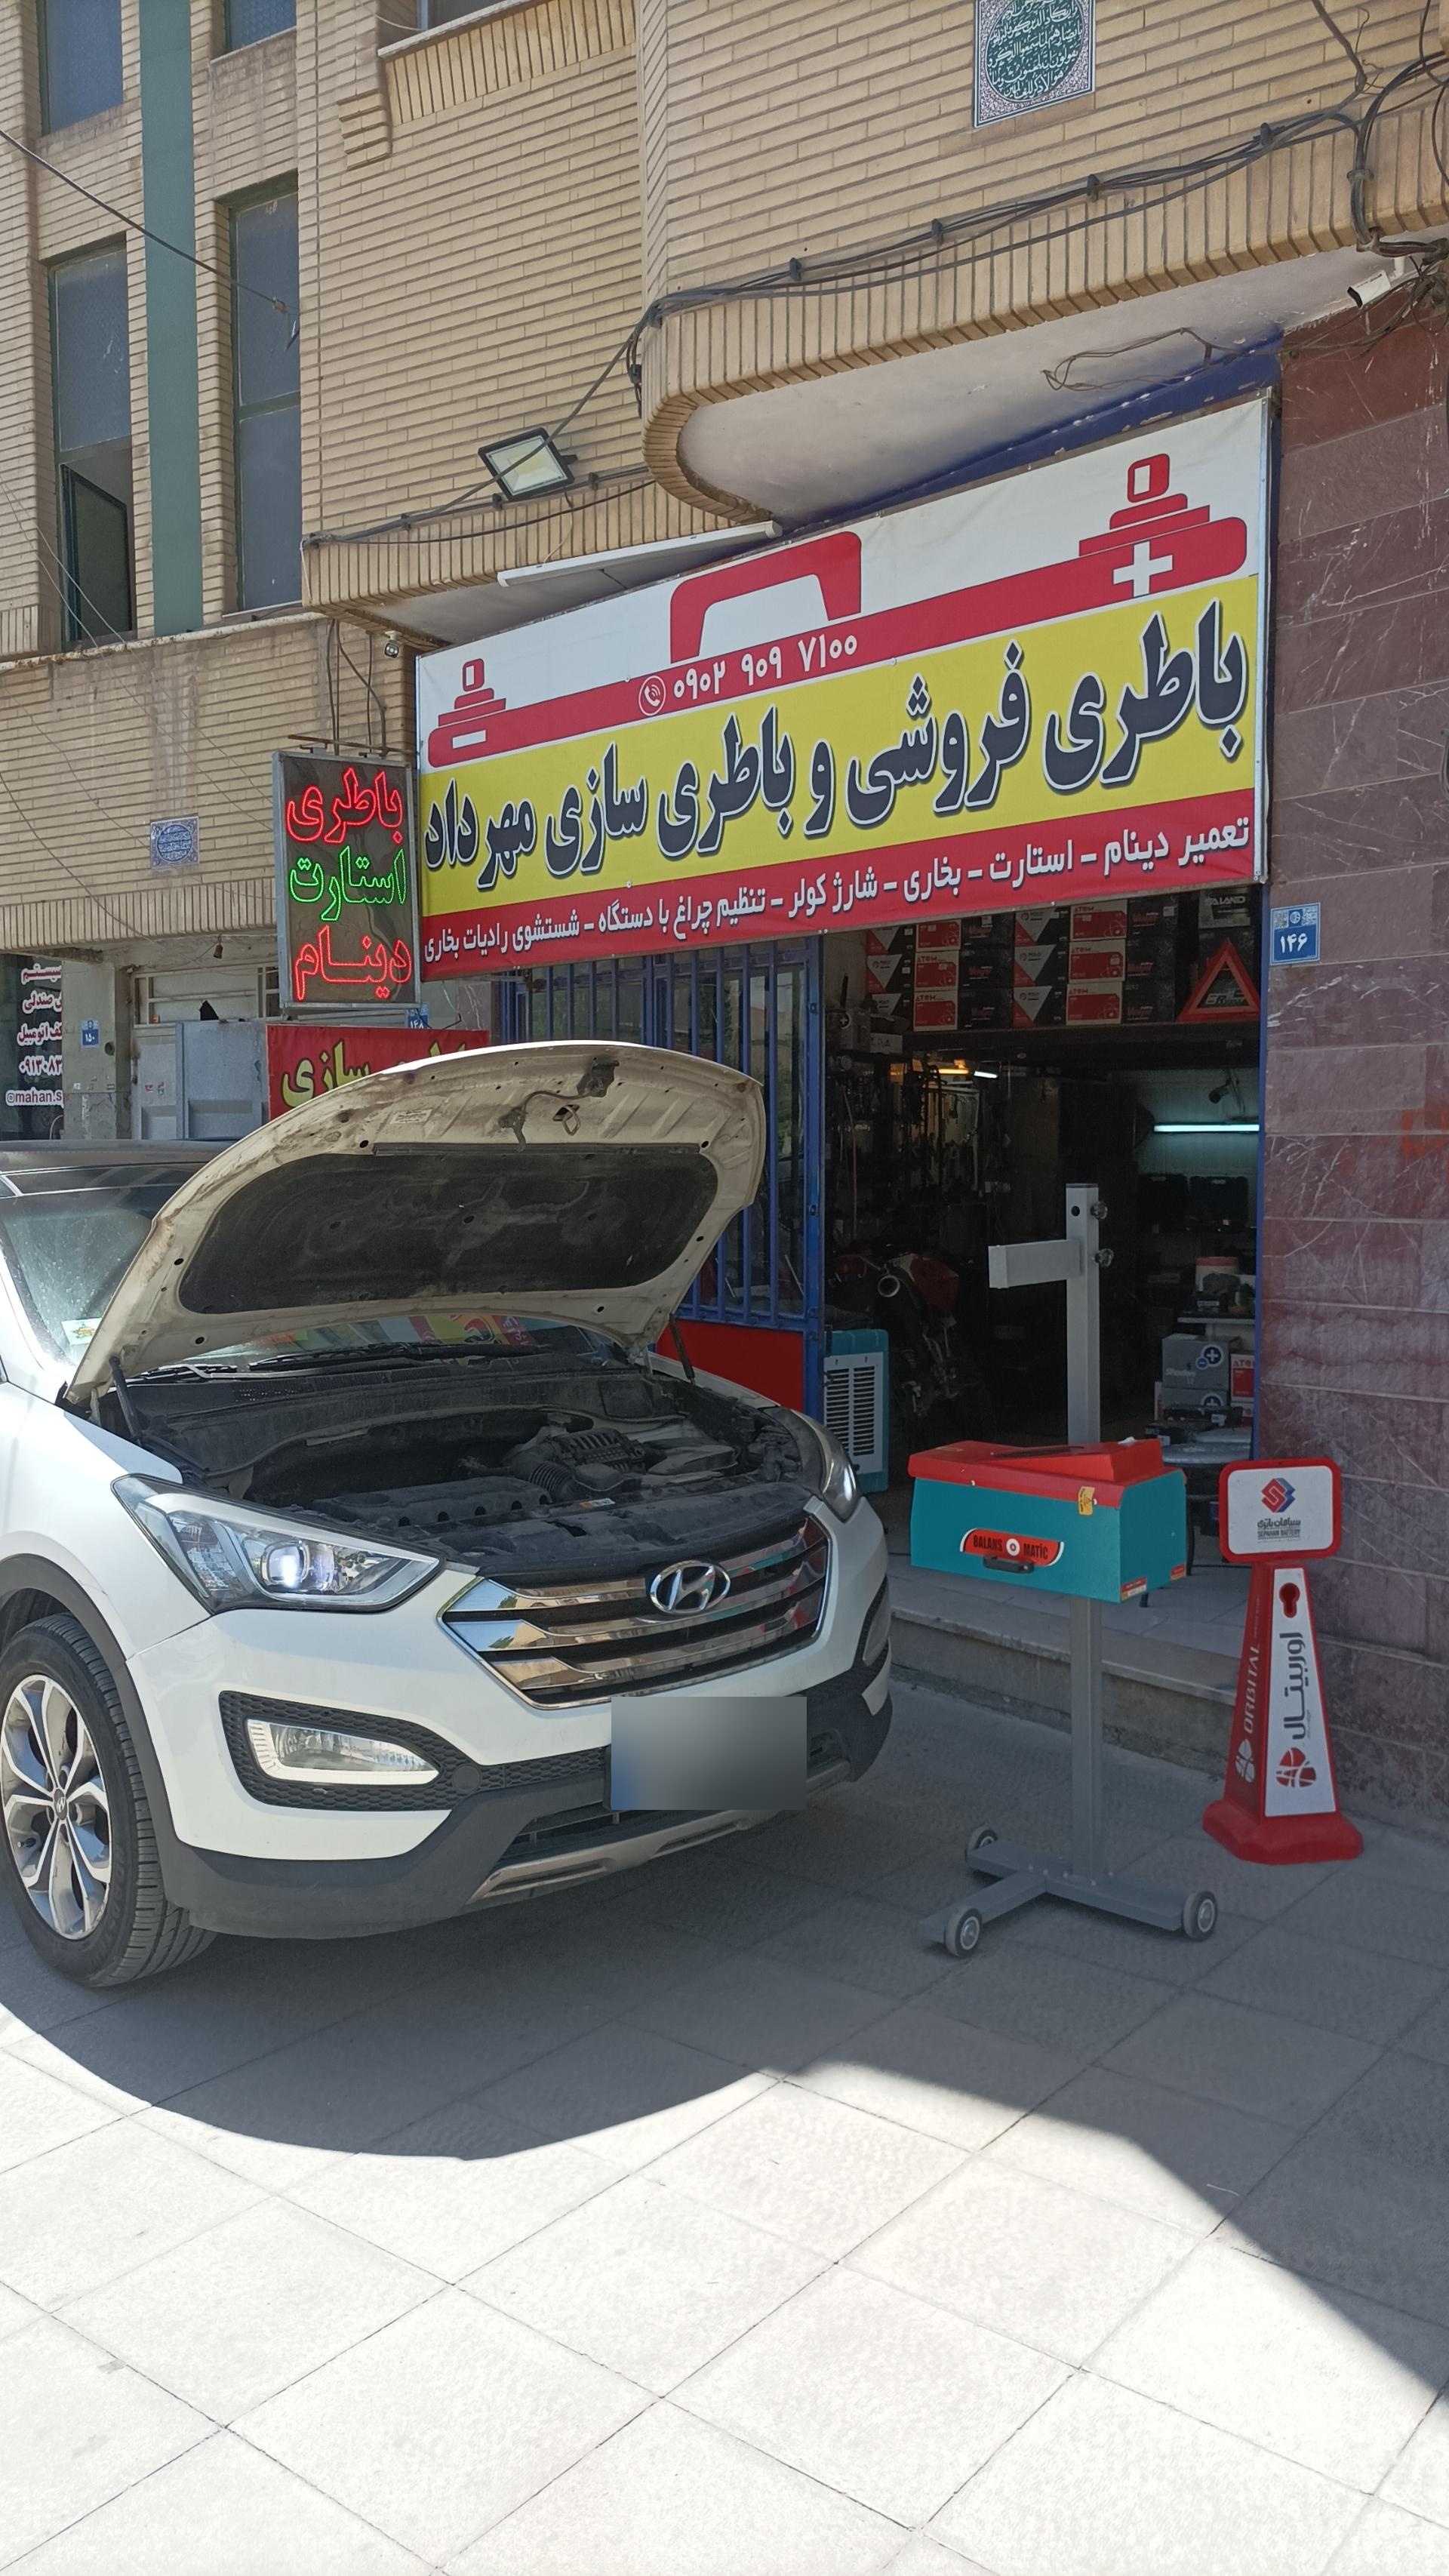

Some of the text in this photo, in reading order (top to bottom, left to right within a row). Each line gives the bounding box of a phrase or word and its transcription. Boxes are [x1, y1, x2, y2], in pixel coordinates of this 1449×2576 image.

[1044, 598, 1247, 791] باطری
[845, 639, 1031, 826] فروشی
[656, 705, 795, 857] باطری
[804, 739, 835, 837] و
[286, 767, 403, 844] باطری
[544, 741, 647, 877] سازی
[989, 839, 1073, 888] استارت
[1103, 829, 1169, 876] دینام
[1178, 816, 1250, 866] تعمیر
[289, 845, 407, 922] استارت
[788, 873, 827, 919] کولر
[832, 866, 878, 913] شارژ
[903, 856, 961, 903] بخاری
[512, 908, 580, 953] شستشوی
[598, 900, 654, 933] دستگاه
[657, 898, 670, 931] با
[673, 895, 712, 940] چراغ
[716, 886, 766, 927] تنظیم
[294, 925, 413, 1001] دینام
[424, 932, 460, 962] بخاری
[1281, 933, 1307, 953] ۱۴۶
[973, 1534, 1003, 1552] BALANS
[1243, 1644, 1260, 1734] ORBITAL
[1279, 1631, 1309, 1740] اوربیتال
